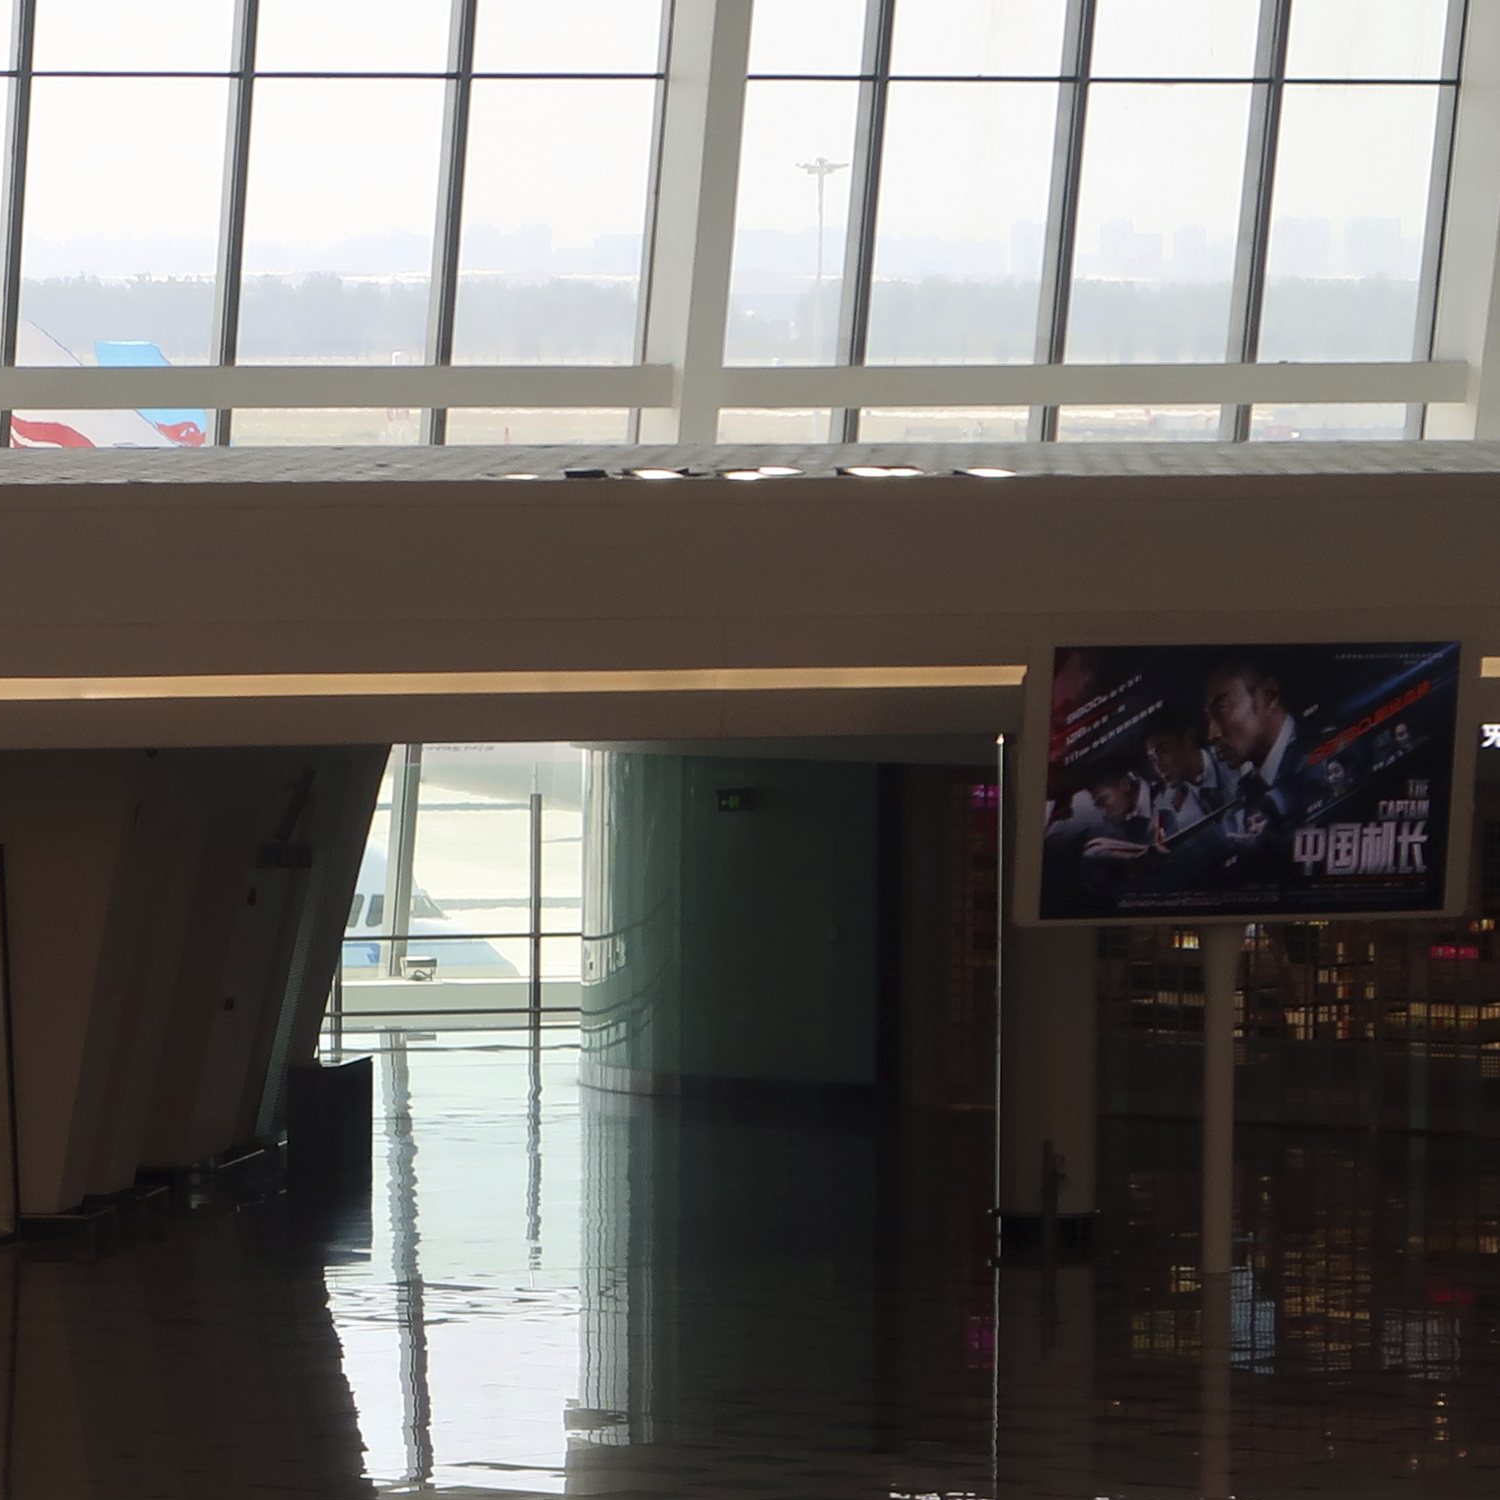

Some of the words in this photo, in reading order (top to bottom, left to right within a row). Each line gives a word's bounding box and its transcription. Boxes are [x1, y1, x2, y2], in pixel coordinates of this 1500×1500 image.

[1407, 779, 1430, 798] THE
[1377, 799, 1430, 820] CAPTAIN
[1293, 821, 1429, 876] 中国机长
